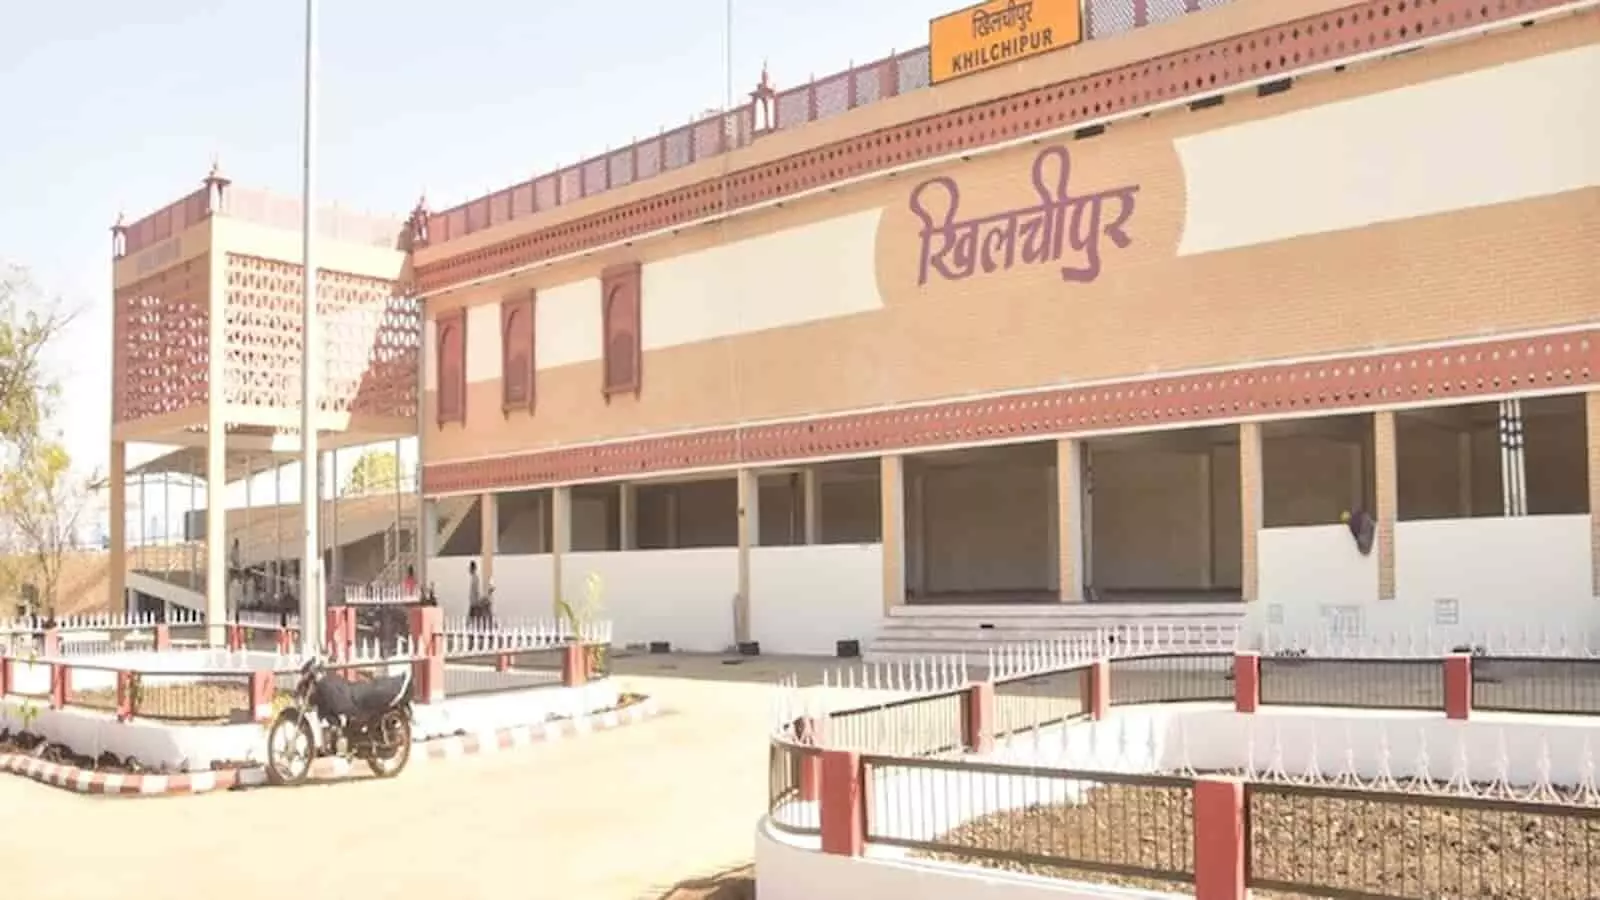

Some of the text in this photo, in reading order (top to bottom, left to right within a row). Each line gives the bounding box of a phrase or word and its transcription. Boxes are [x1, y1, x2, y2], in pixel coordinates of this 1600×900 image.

[972, 0, 1033, 39] खिलचीपुर
[952, 27, 1053, 73] KHILCHIPUR
[909, 145, 1140, 286] खिलचीपुर
